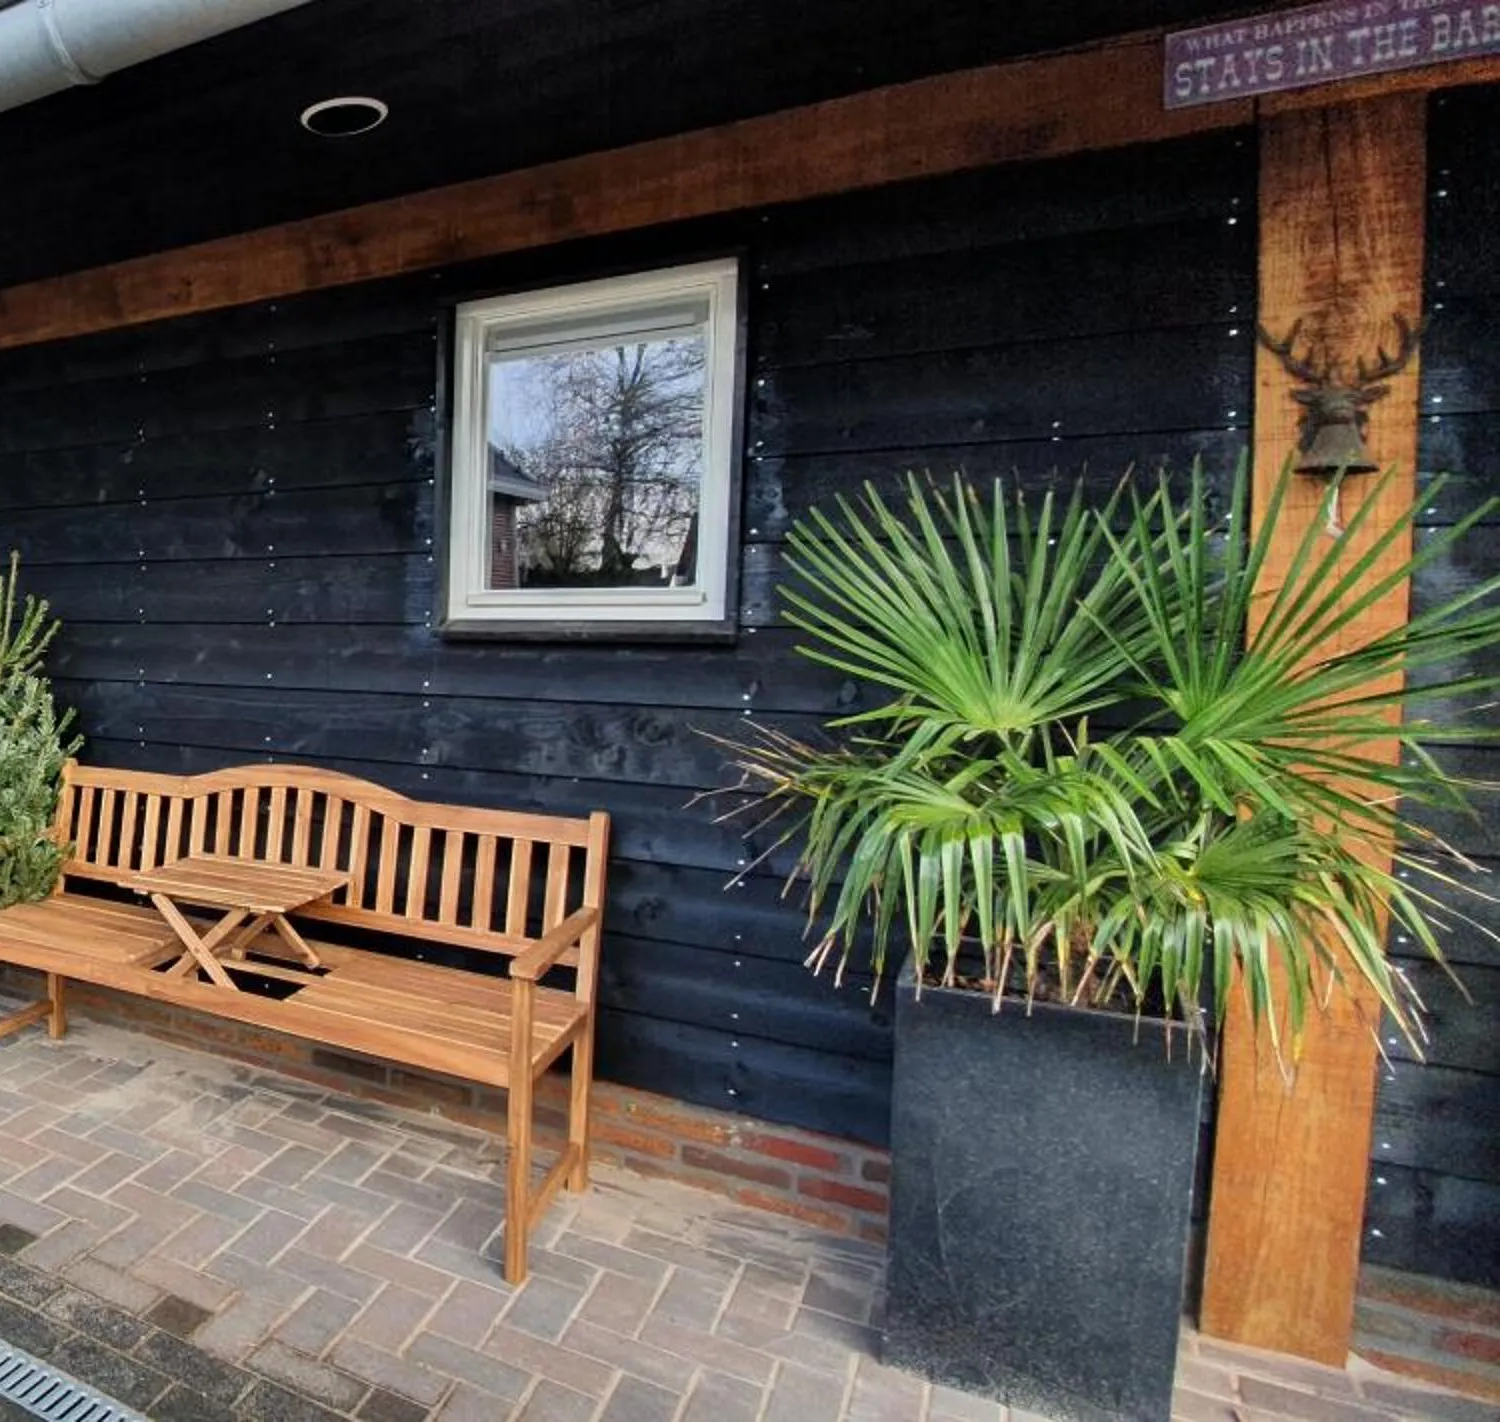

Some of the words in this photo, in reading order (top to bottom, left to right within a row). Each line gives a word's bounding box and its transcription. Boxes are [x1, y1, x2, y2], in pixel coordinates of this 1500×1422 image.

[1174, 45, 1284, 97] STAYS
[1295, 35, 1334, 77] IN
[1347, 18, 1420, 65] THE
[1185, 29, 1247, 53] WHAT
[1253, 6, 1357, 40] HAPPENS
[1363, 1, 1389, 19] IN
